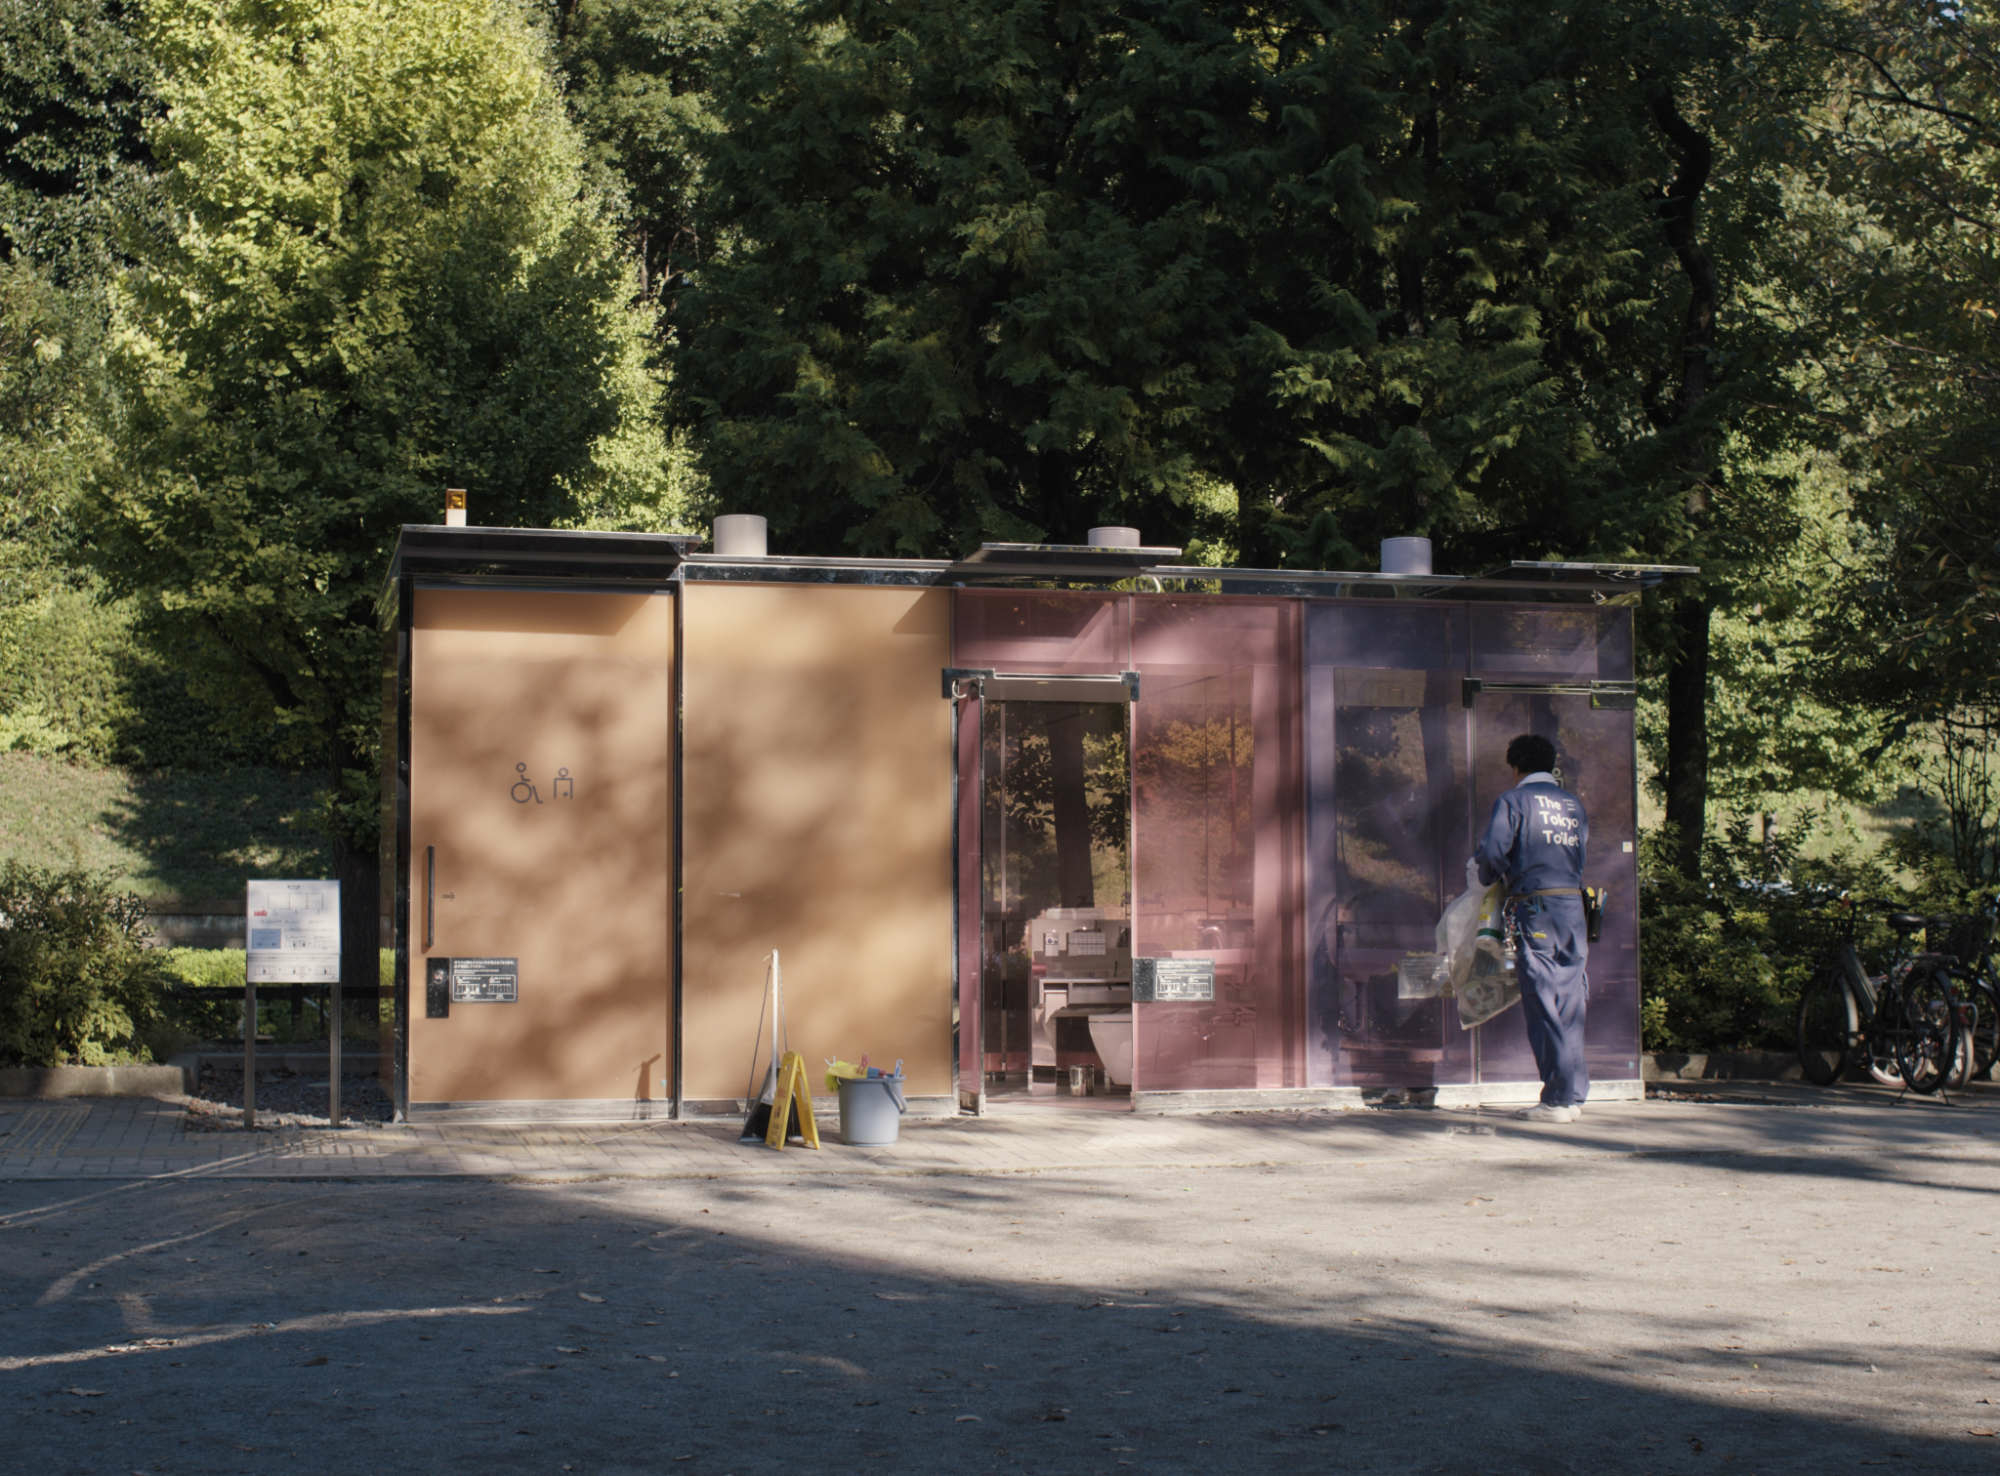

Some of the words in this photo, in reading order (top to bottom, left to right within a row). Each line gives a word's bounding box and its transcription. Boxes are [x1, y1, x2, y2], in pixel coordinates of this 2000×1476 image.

[1534, 795, 1562, 810] The
[1539, 811, 1579, 830] Tokyo
[1542, 830, 1579, 847] Toilet
